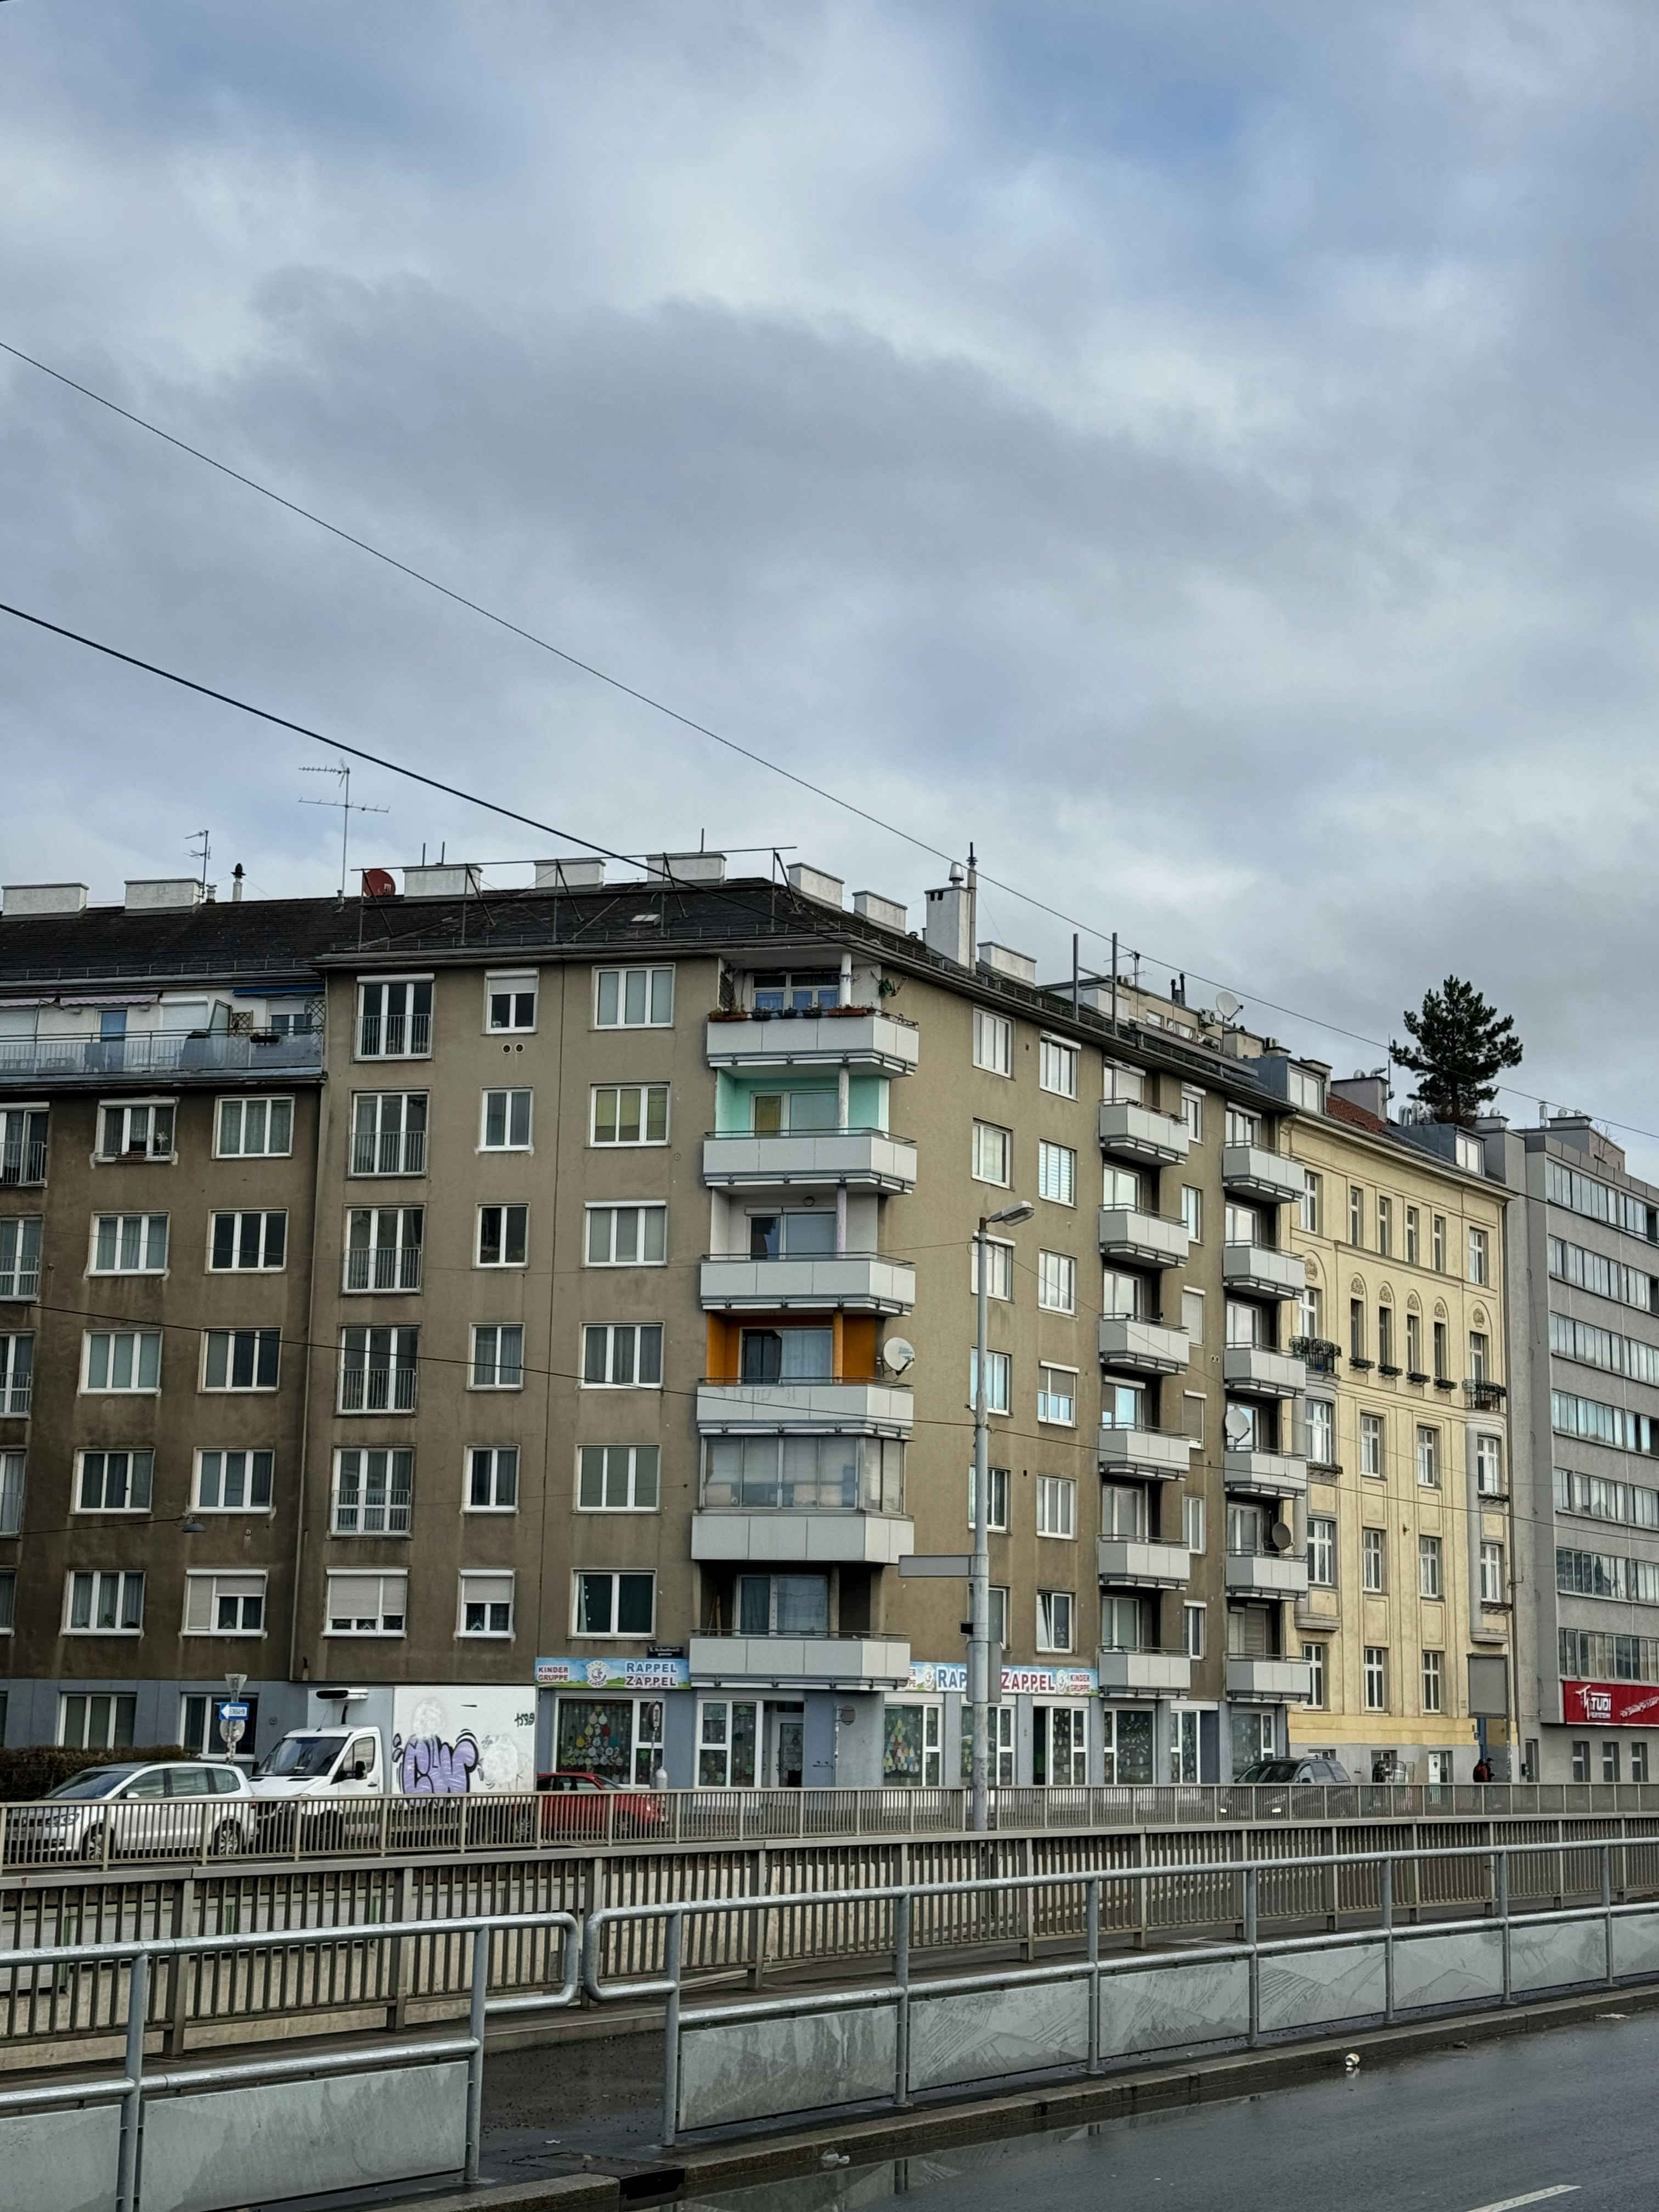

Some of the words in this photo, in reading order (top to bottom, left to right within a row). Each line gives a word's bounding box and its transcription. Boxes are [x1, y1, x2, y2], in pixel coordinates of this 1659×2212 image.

[627, 1663, 677, 1673] RAPPEL
[626, 1676, 676, 1686] ZAPPEL
[938, 1669, 967, 1688] RAP
[1001, 1672, 1055, 1690] ZAPPEL
